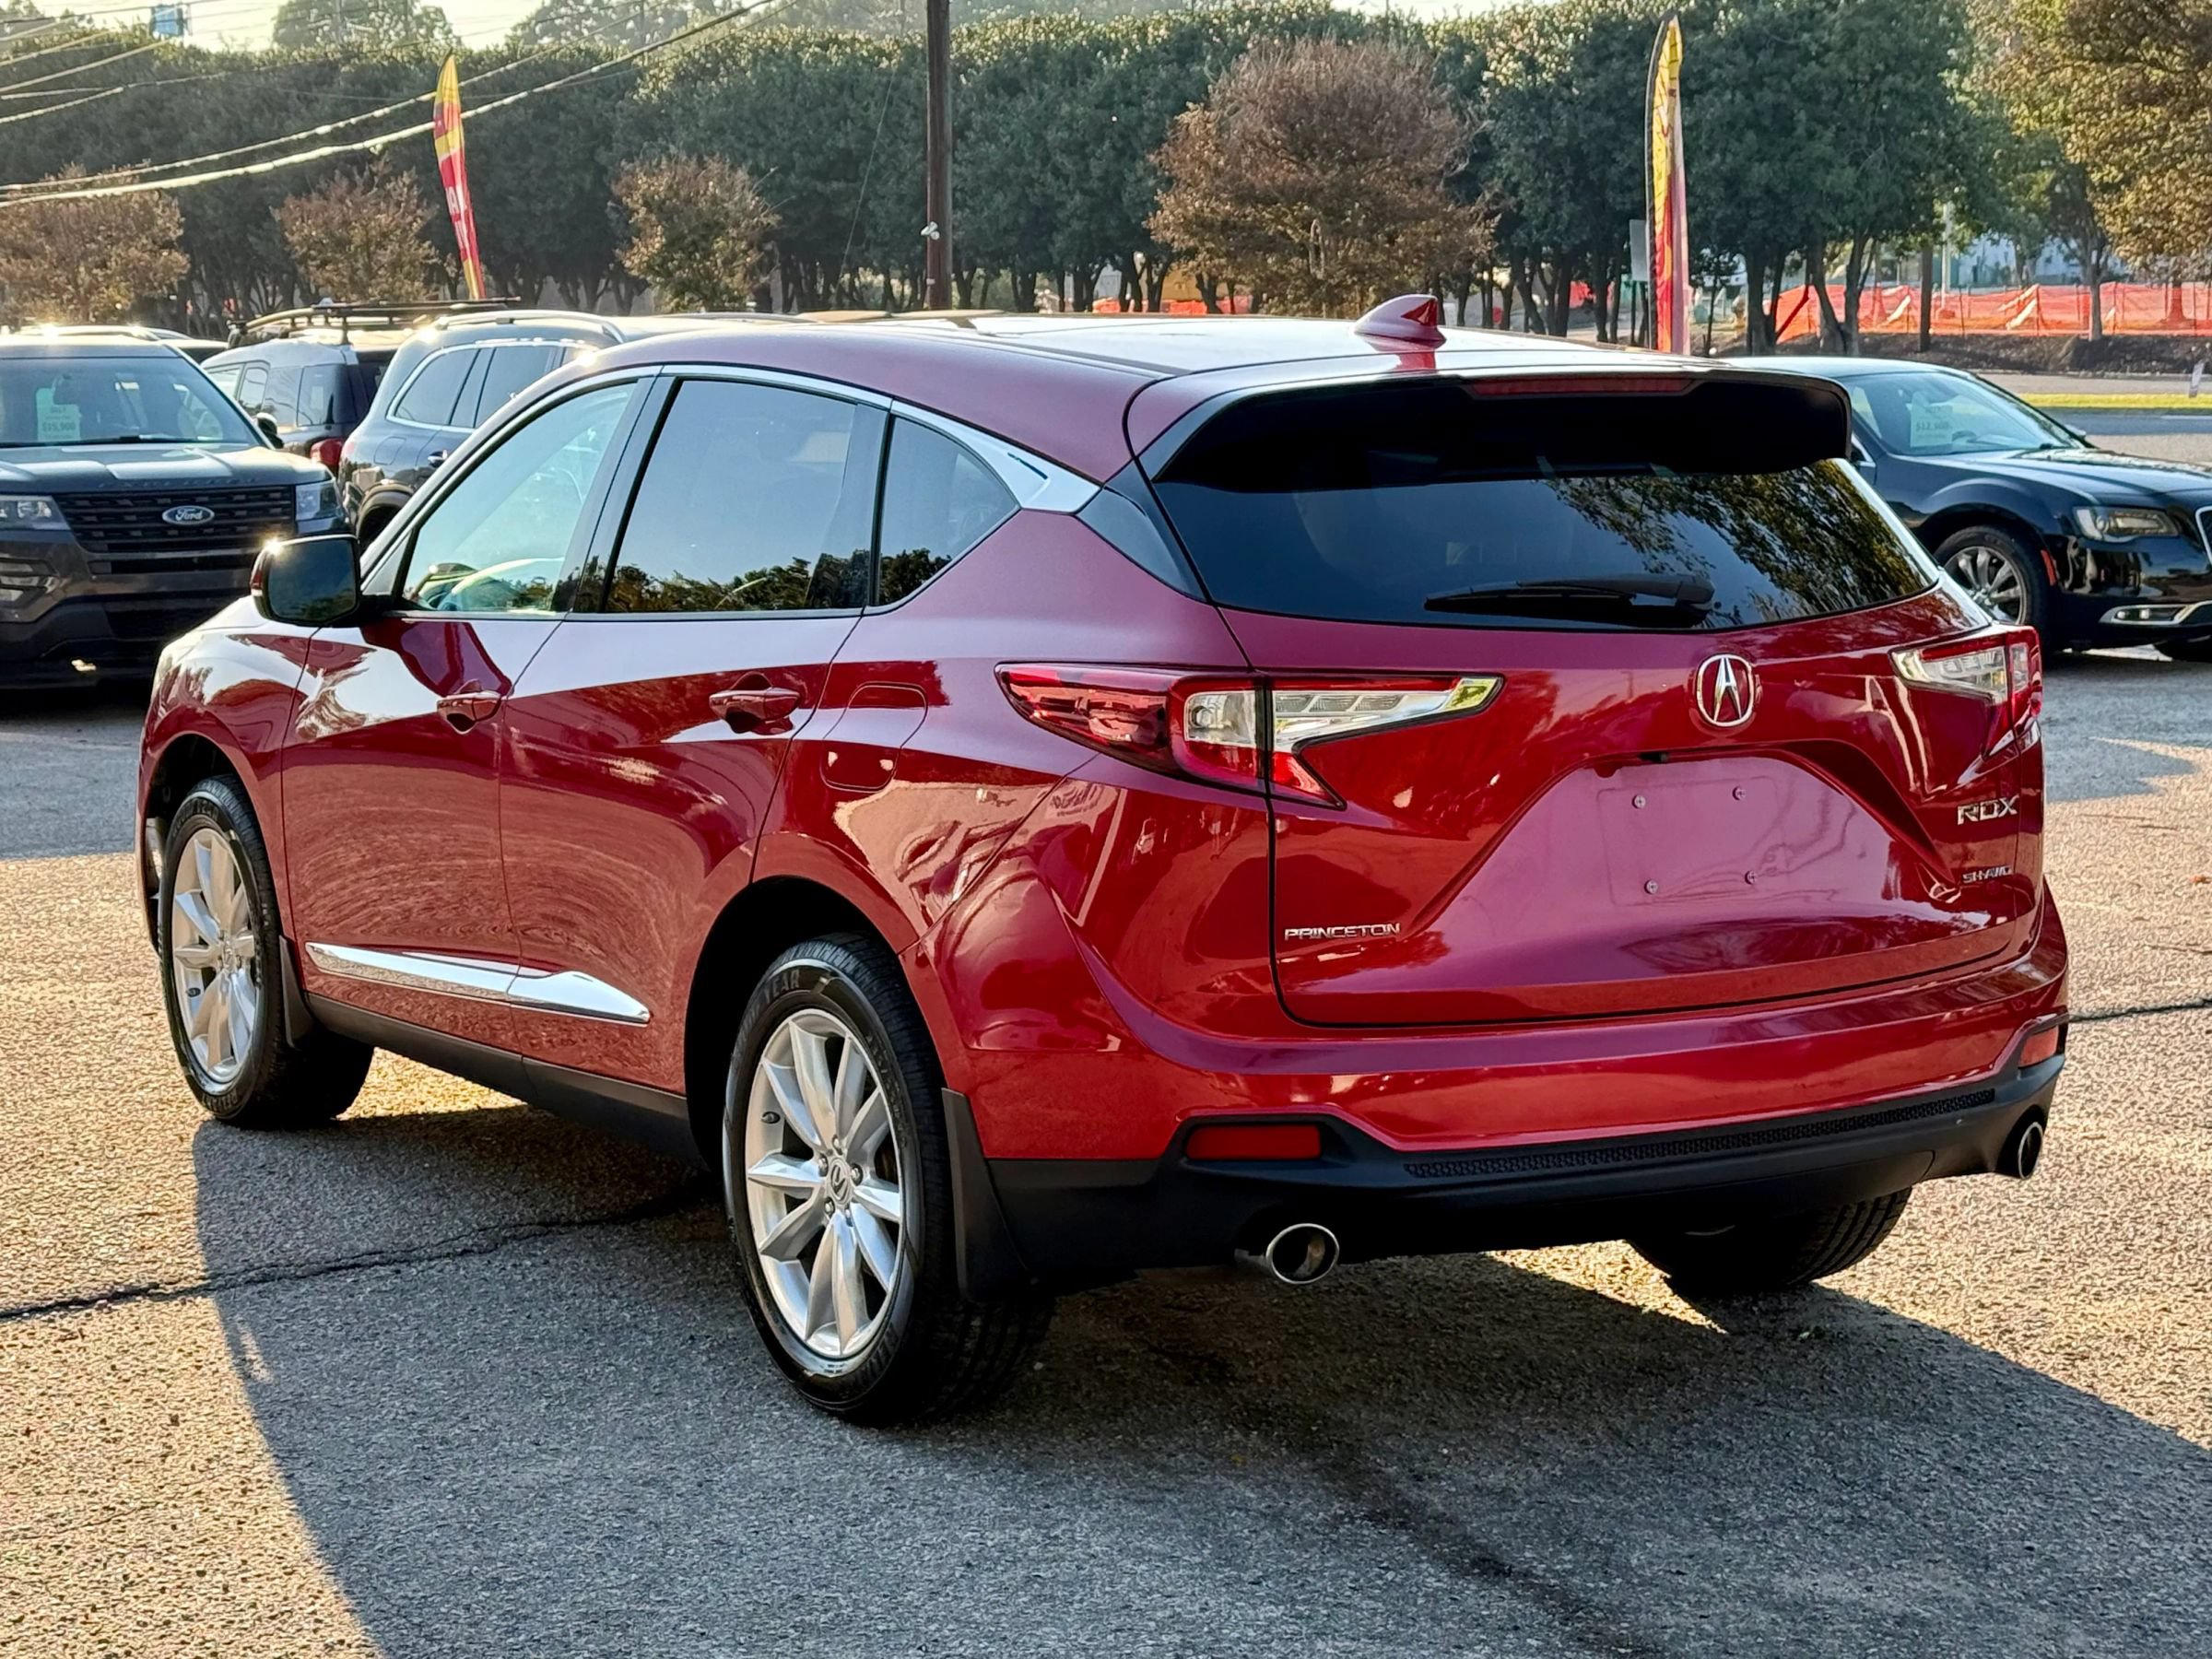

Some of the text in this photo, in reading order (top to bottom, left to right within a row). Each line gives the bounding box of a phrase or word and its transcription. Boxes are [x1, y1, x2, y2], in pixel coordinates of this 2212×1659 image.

[175, 509, 203, 522] Ford
[1957, 794, 2019, 825] RDX
[1284, 923, 1400, 941] PRINCETON
